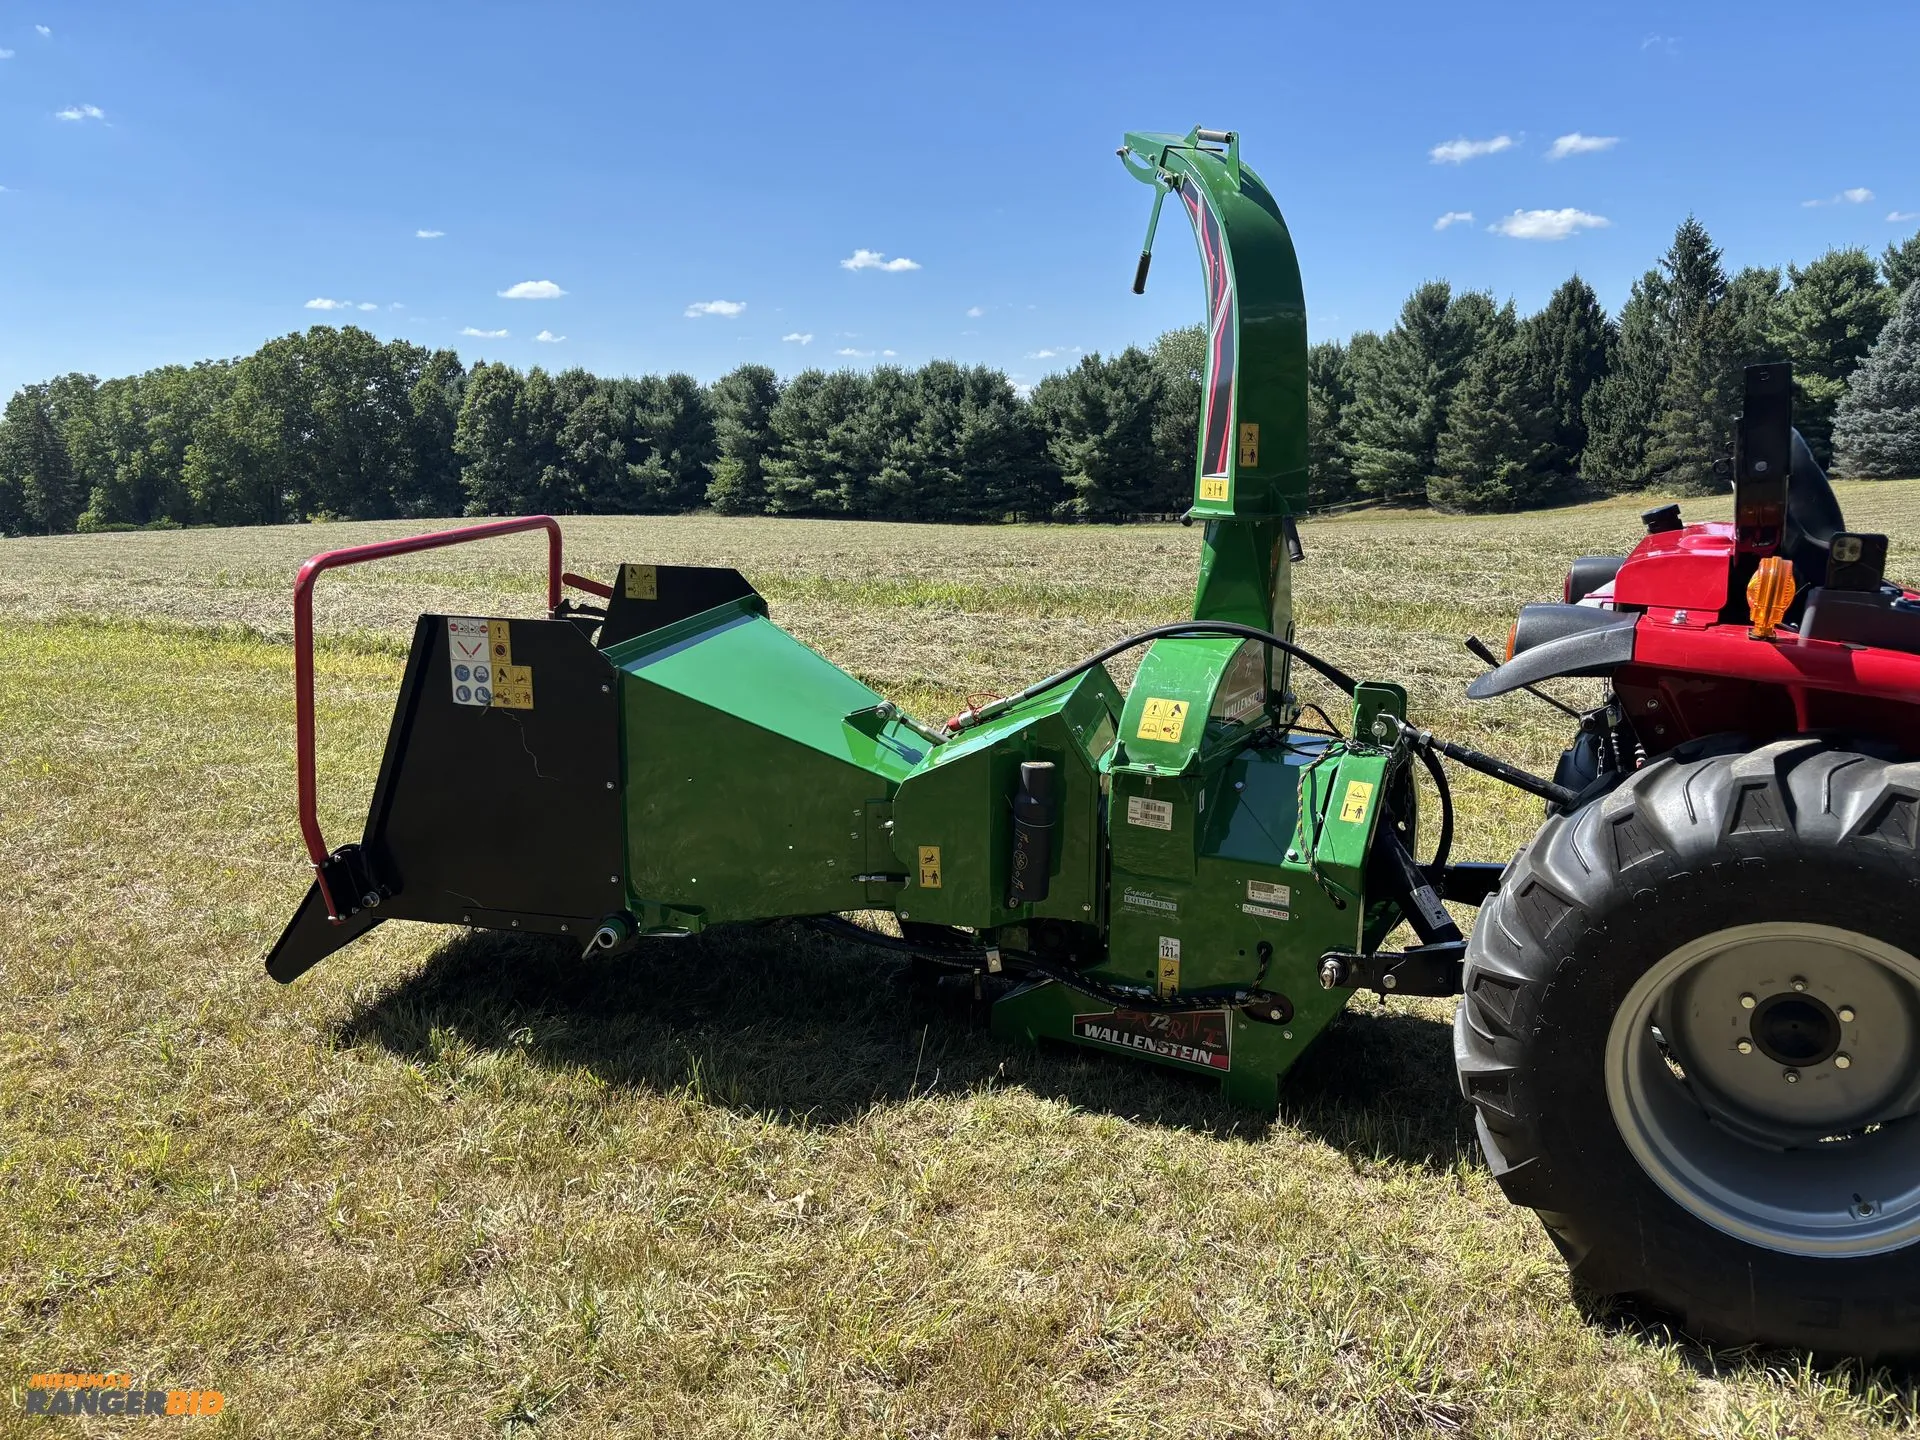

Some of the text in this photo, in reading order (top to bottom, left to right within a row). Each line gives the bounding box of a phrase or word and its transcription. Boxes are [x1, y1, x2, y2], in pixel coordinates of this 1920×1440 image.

[1124, 886, 1154, 898] Capital
[1125, 895, 1176, 910] EQUIPMENT
[1161, 945, 1174, 958] 121
[1150, 1014, 1171, 1031] 72
[1084, 1023, 1213, 1065] WALLENSTEIN
